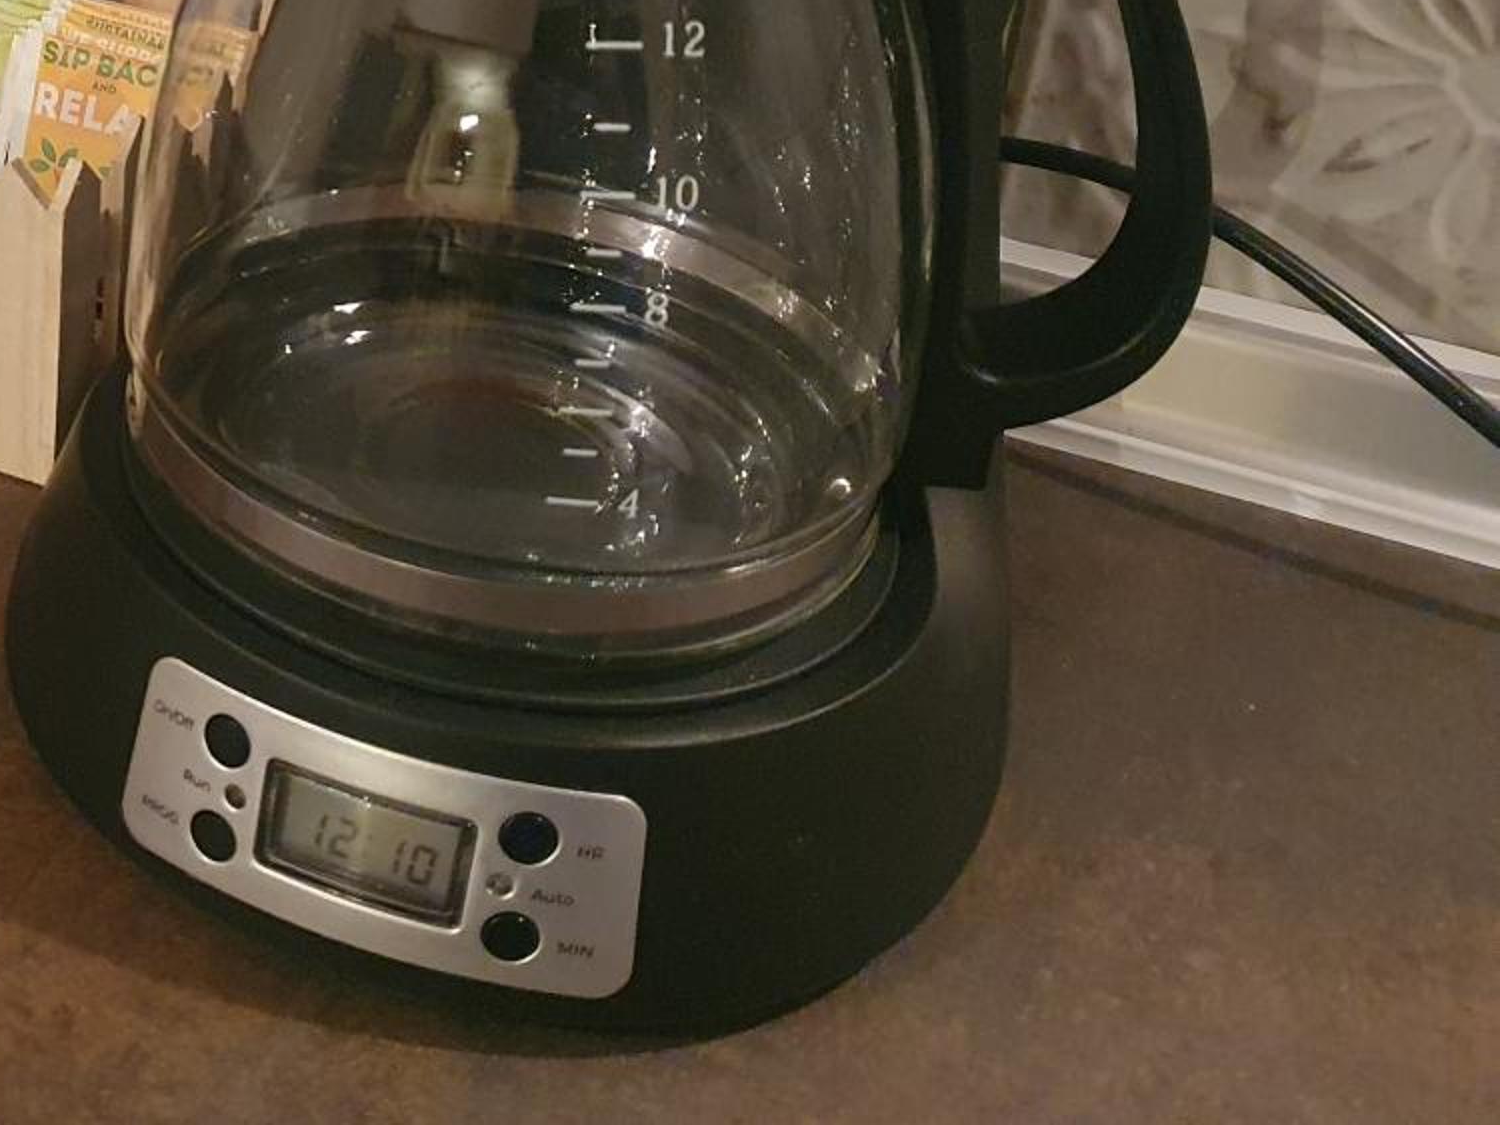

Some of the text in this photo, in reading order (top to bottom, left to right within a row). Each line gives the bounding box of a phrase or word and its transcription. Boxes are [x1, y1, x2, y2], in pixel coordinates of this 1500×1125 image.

[661, 20, 706, 59] 12
[43, 40, 91, 71] SIP
[95, 54, 159, 87] BAC
[92, 81, 117, 93] AND
[36, 80, 139, 137] RELA
[653, 175, 700, 212] 10
[643, 293, 669, 329] 8
[618, 488, 640, 519] 4
[531, 888, 576, 907] Auto
[556, 941, 595, 958] MIN
